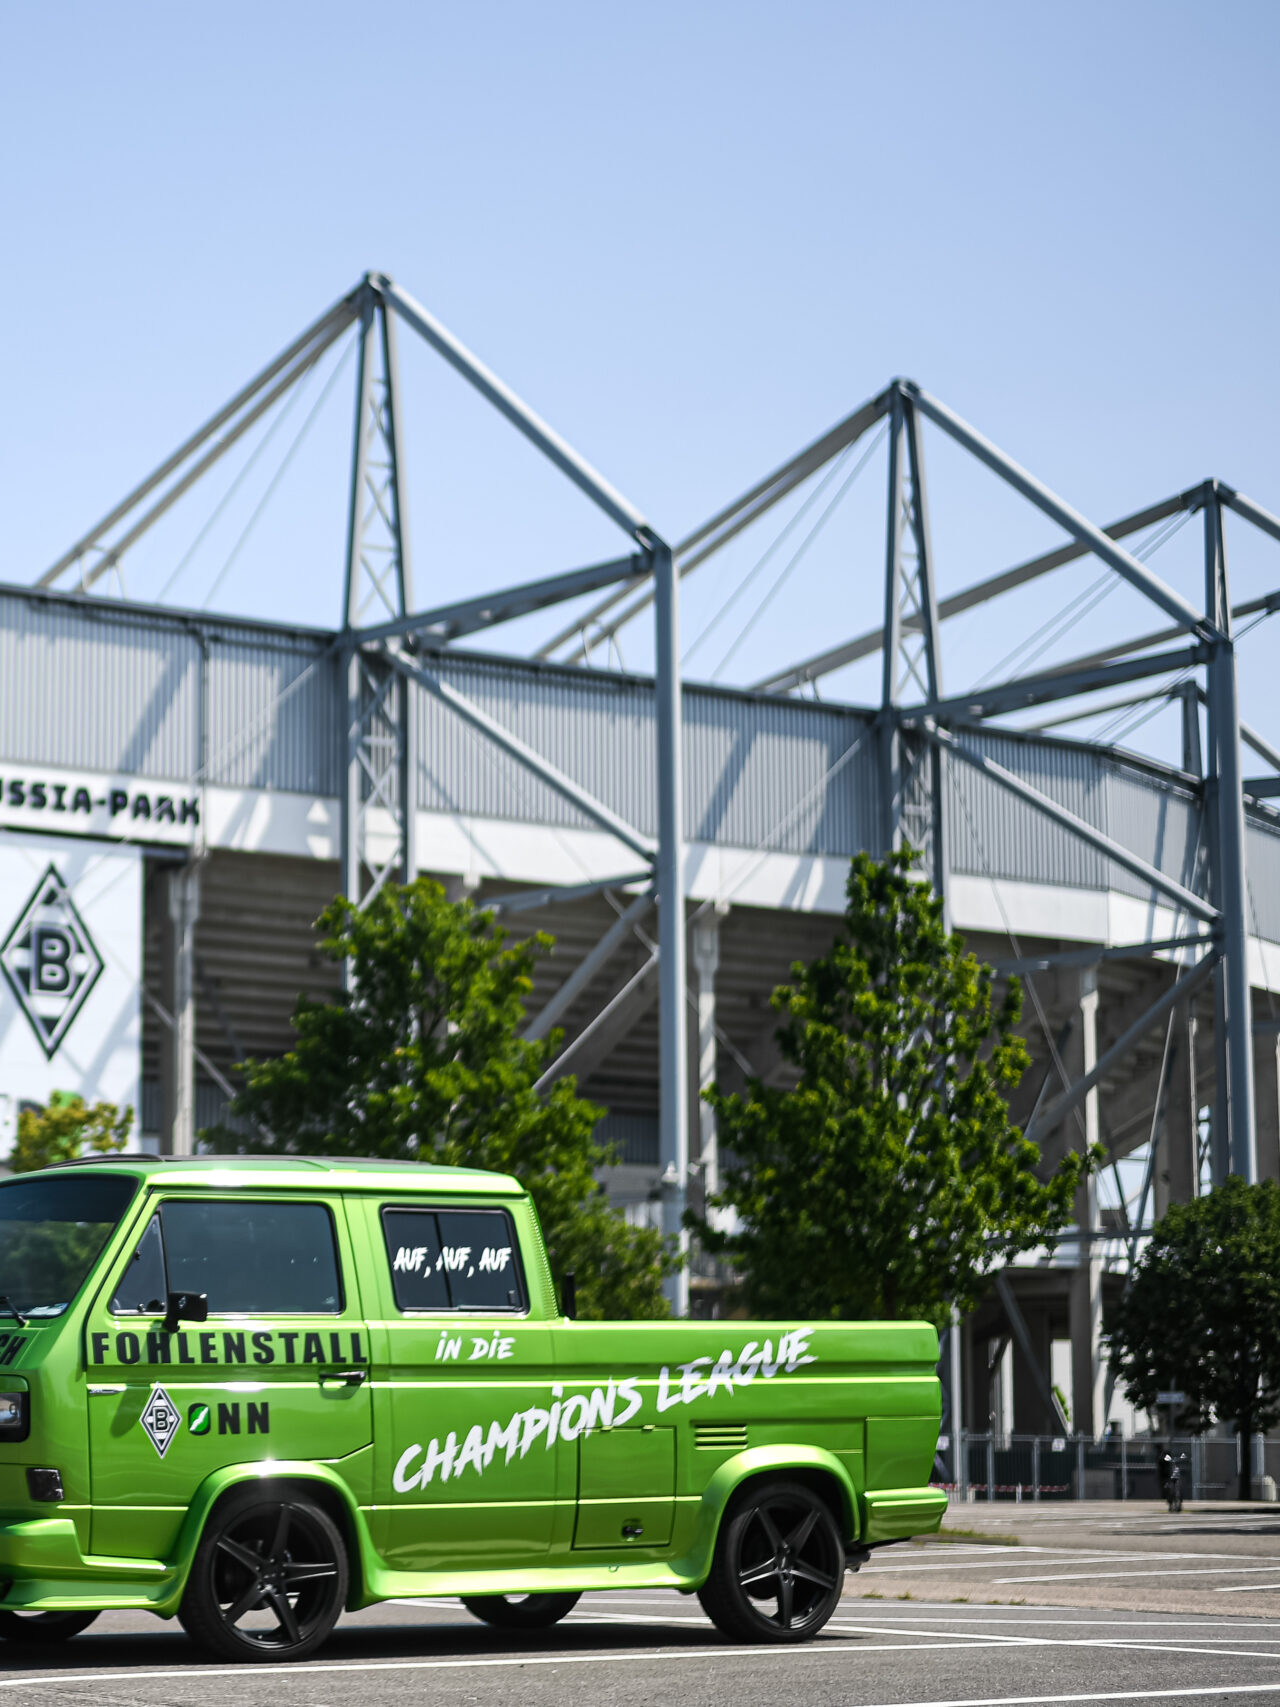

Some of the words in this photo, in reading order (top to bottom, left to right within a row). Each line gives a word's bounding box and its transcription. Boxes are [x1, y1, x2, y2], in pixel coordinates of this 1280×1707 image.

[33, 926, 71, 993] B
[393, 1246, 431, 1279] AUF,
[435, 1246, 474, 1279] AUF,
[478, 1246, 512, 1274] AUF
[91, 1331, 368, 1365] FOHLENSTALL
[657, 1327, 818, 1413] LEAGUE
